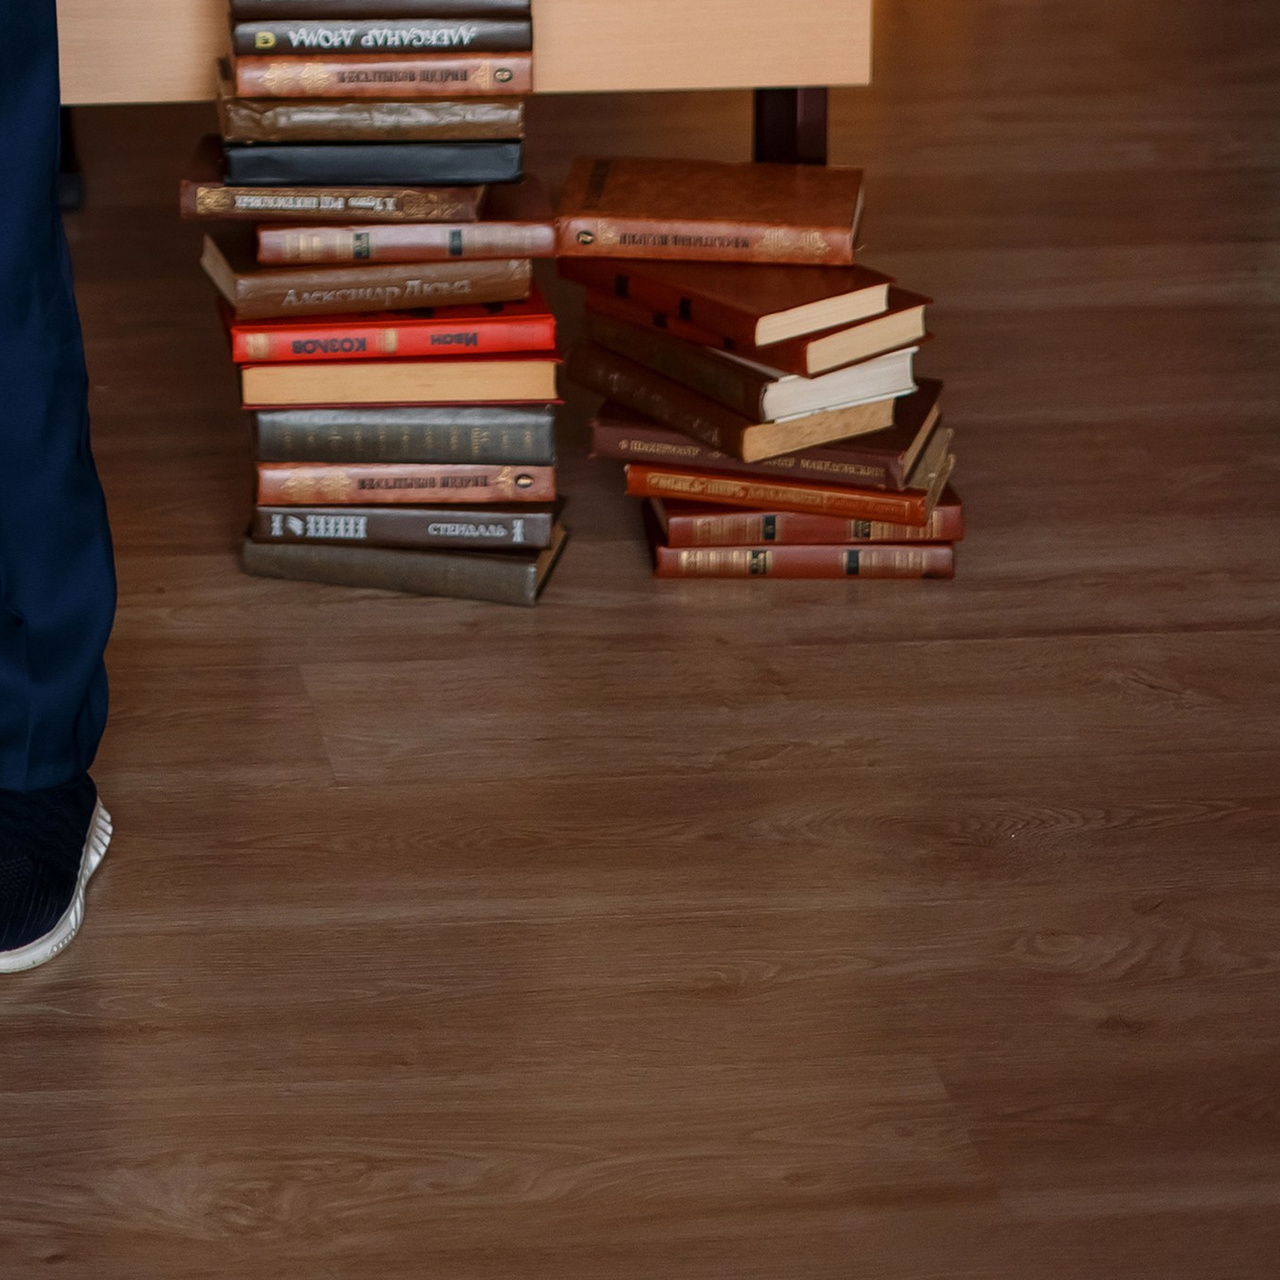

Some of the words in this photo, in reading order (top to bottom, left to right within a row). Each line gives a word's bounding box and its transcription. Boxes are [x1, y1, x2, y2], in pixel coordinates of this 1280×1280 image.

[287, 27, 356, 49] ДЮМА
[360, 26, 477, 49] АЛЕКСАНДР
[292, 336, 367, 355] КОЗЛОВ
[430, 333, 478, 347] Иван
[427, 521, 508, 538] СТЕНДАЛЬ
